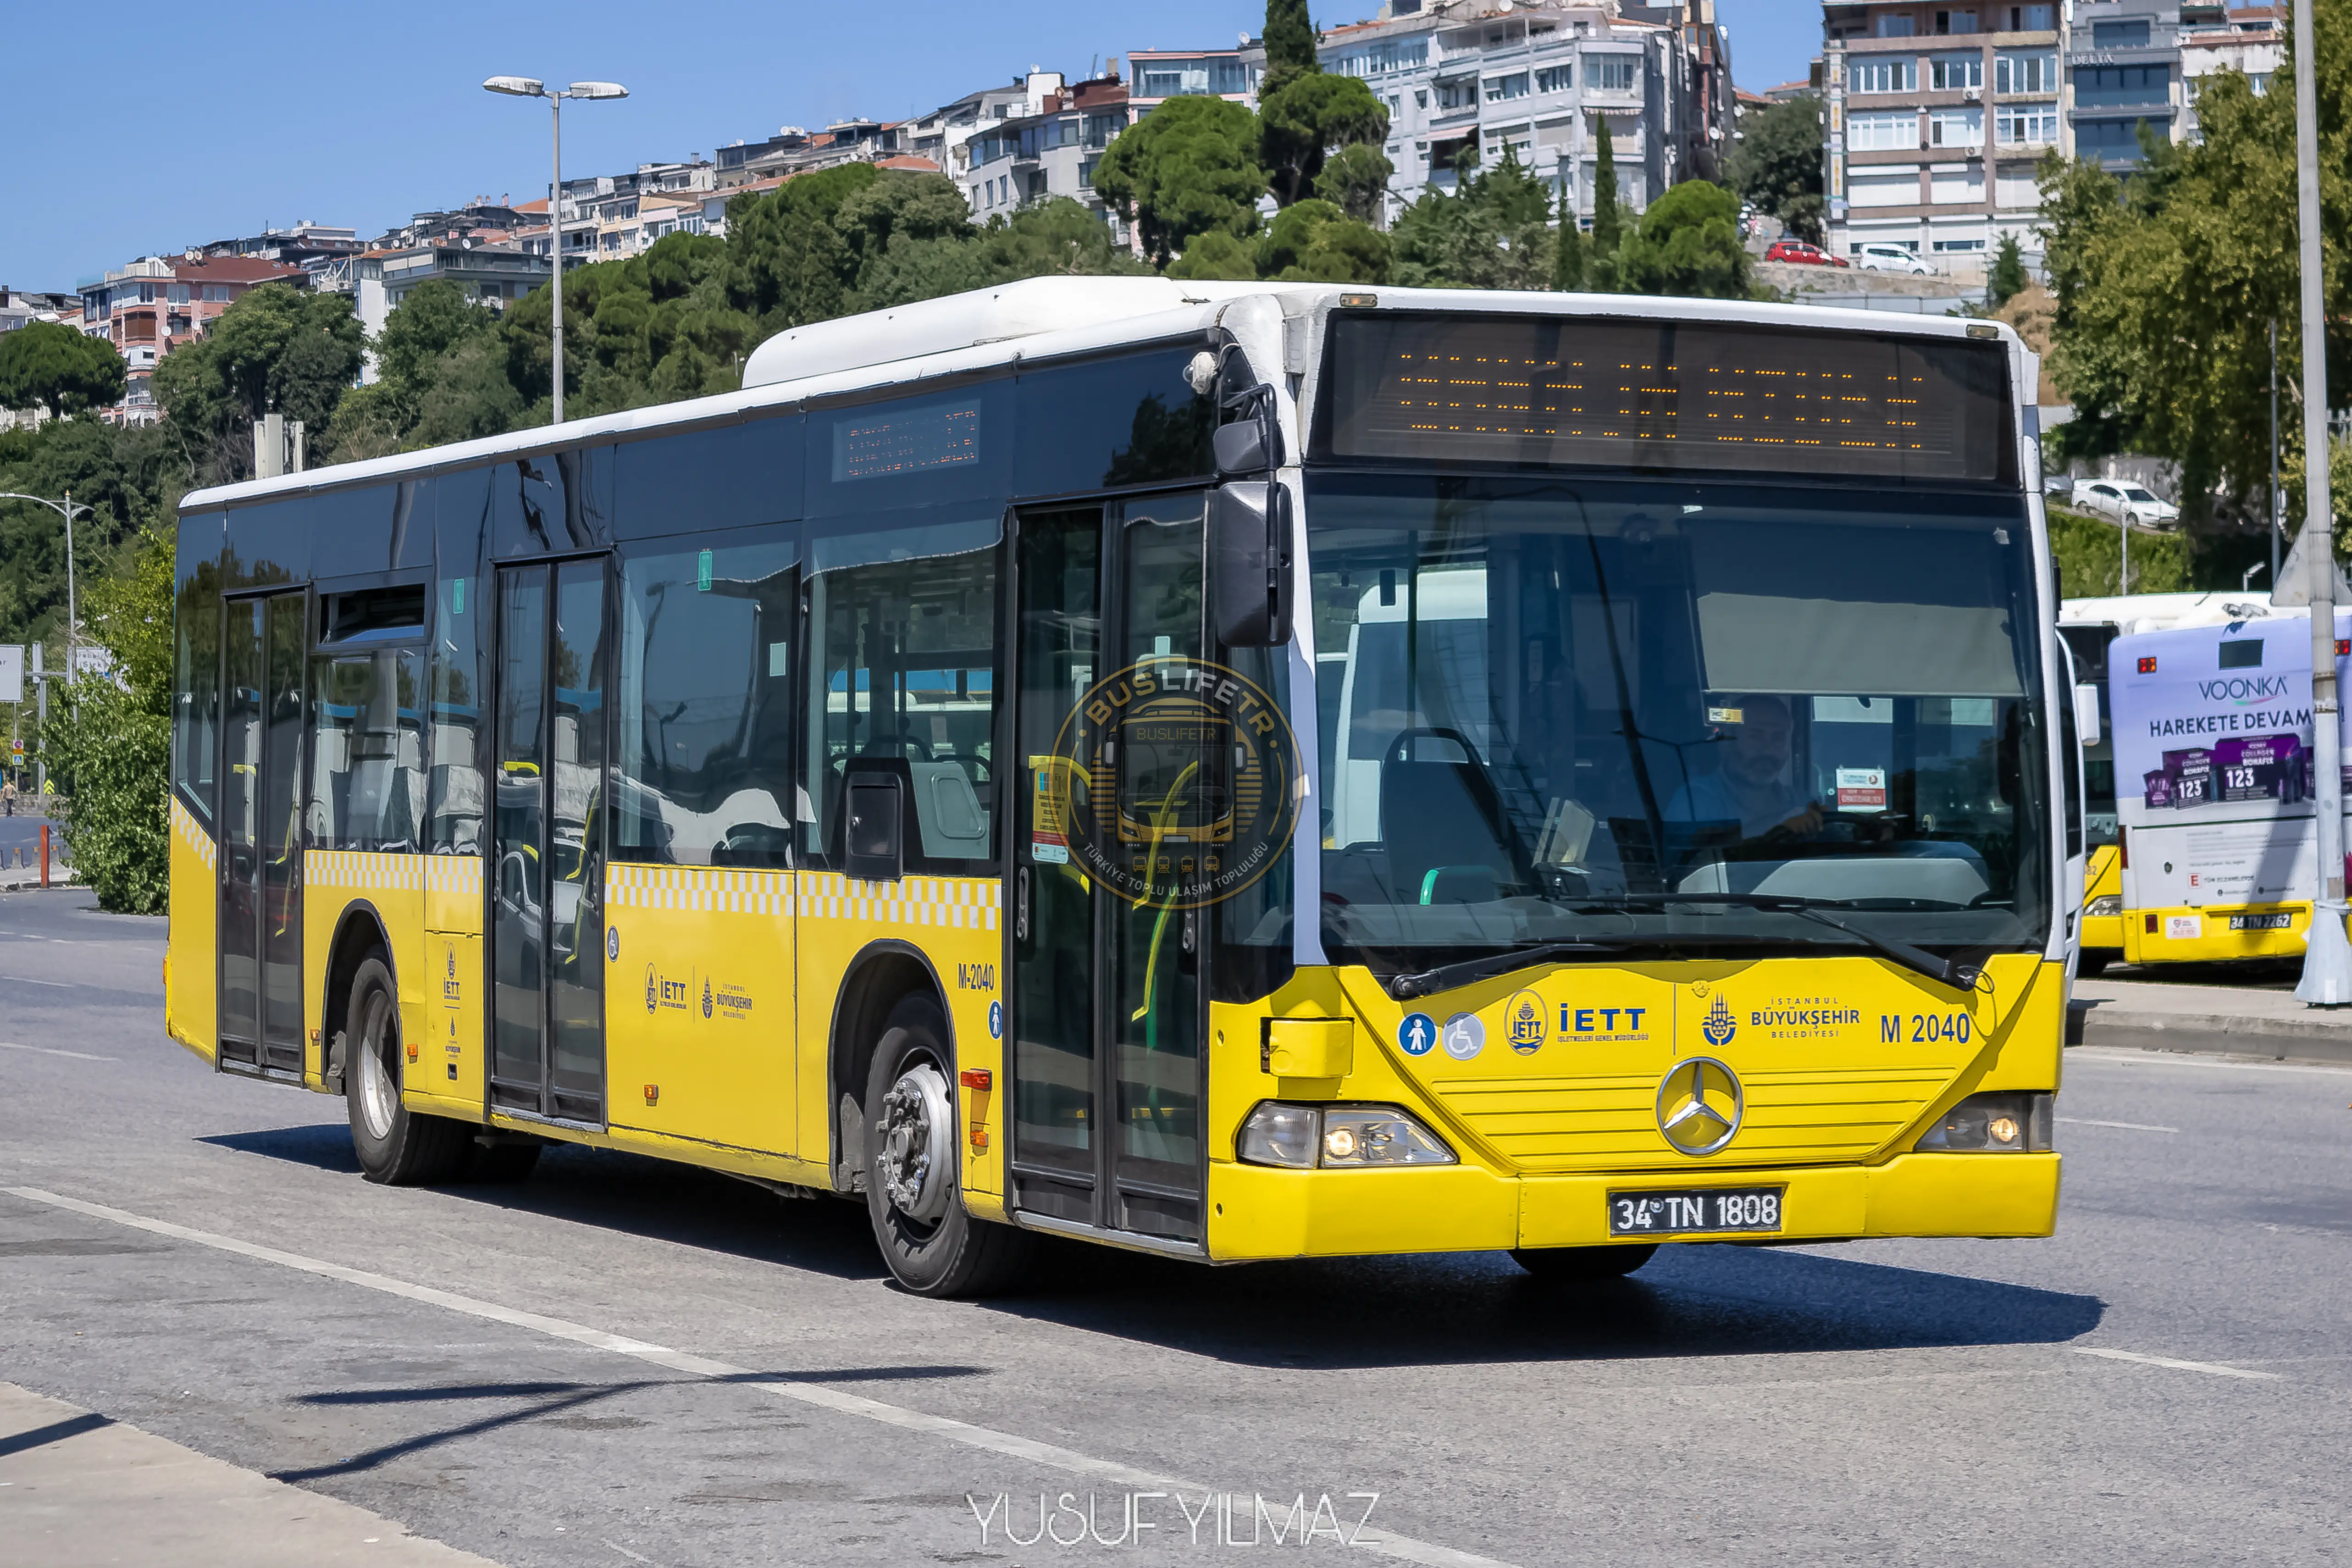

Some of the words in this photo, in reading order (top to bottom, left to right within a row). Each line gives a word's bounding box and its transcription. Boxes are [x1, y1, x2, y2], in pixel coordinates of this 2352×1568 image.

[2198, 676, 2288, 701] VOONKA
[2150, 713, 2239, 737] HAREKETE
[2244, 708, 2313, 730] DEVAM
[2178, 779, 2202, 799] 123
[2227, 767, 2254, 788] 123
[2231, 916, 2244, 929] 34
[2248, 917, 2261, 929] TN
[444, 976, 460, 995] İETT
[660, 975, 686, 1002] İETT
[723, 981, 745, 993] İSTANBUL
[958, 963, 994, 992] M-2040
[717, 990, 753, 1012] BÜYÜKŞEHİR
[1771, 996, 1839, 1006] İSTANBUL
[1560, 1003, 1646, 1032] İETT
[1751, 1005, 1861, 1030] BÜYÜKŞEHİR
[1881, 1015, 1900, 1043] M
[1911, 1013, 1970, 1044] 2040
[1771, 1028, 1839, 1039] BELEDİYESİ
[1617, 1198, 1653, 1230] 34
[1665, 1196, 1705, 1228] TN
[1716, 1194, 1778, 1225] 1808
